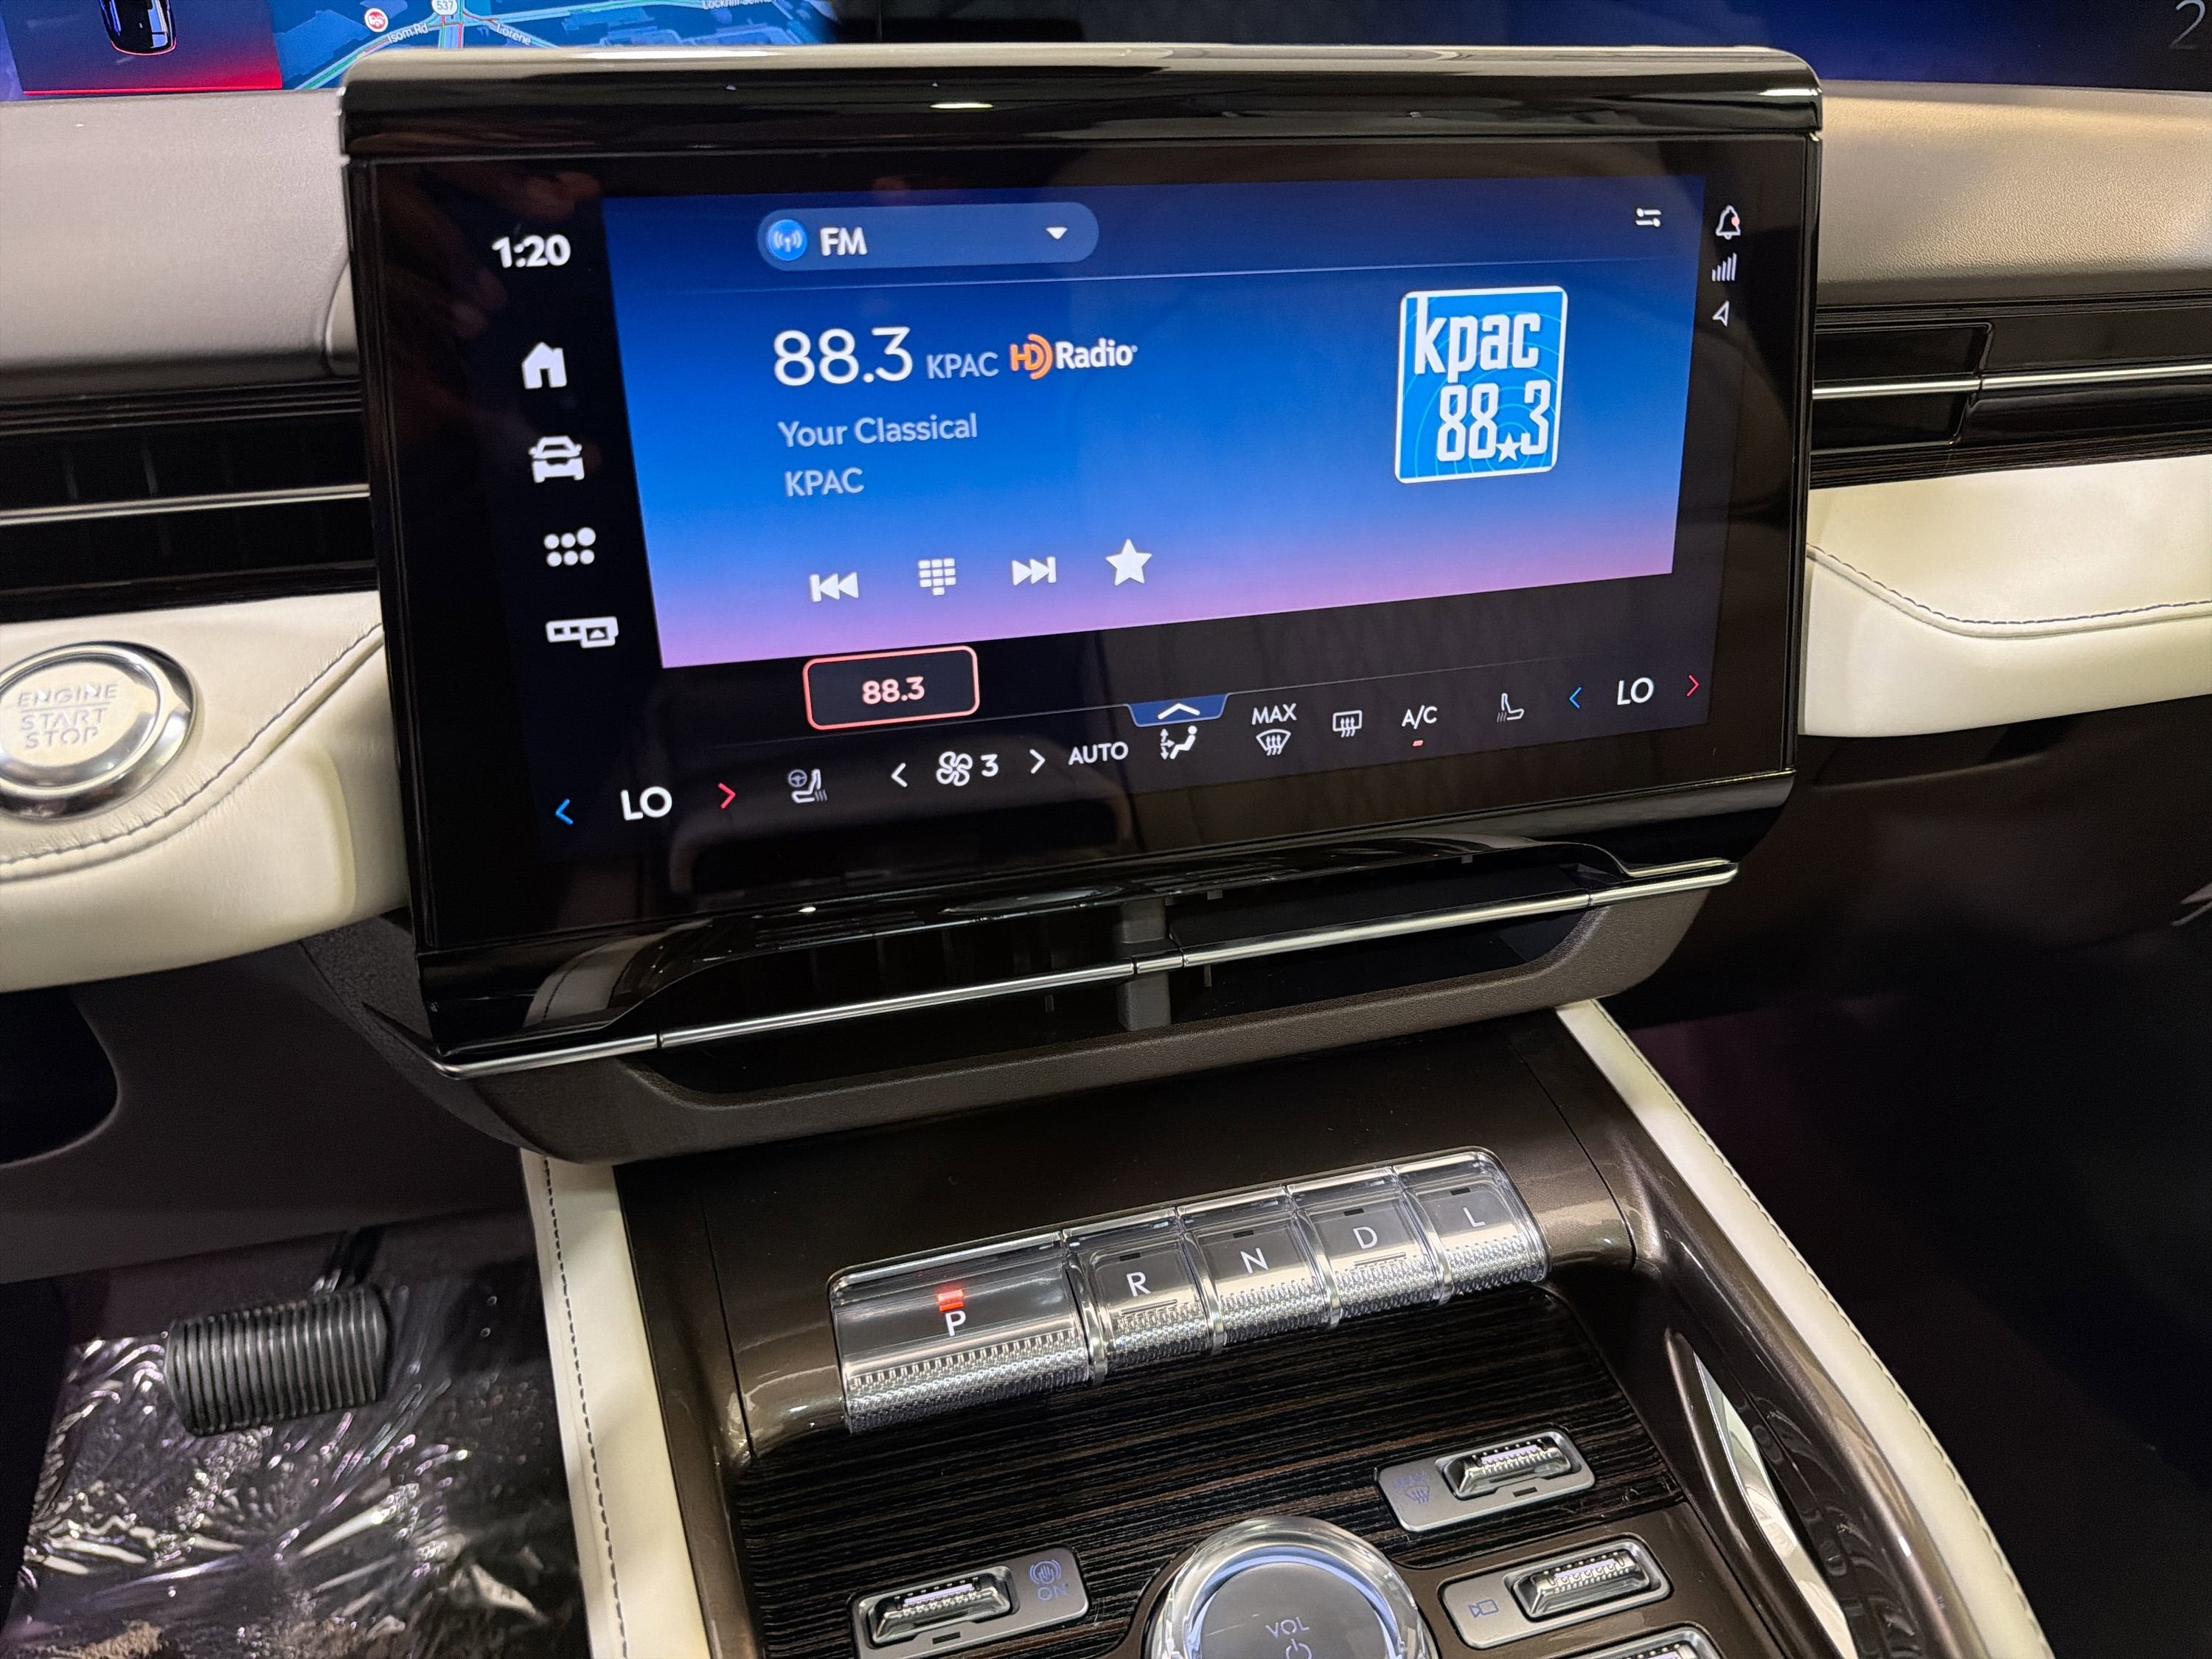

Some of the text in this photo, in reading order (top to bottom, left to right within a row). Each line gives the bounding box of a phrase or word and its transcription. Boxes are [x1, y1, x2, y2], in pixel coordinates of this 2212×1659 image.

[437, 0, 453, 10] 537
[388, 23, 429, 44] Isom Rd
[496, 22, 532, 46] Lorene
[2169, 0, 2205, 49] 2
[492, 234, 571, 268] 1:20
[819, 227, 868, 257] FM
[1413, 293, 1541, 383] kpac
[773, 326, 914, 386] 88.3
[926, 351, 999, 379] KPAC
[778, 412, 978, 448] Your Classical
[785, 466, 864, 498] KPAC
[17, 682, 119, 708] ENGINE
[862, 675, 926, 706] 88.3
[1616, 677, 1655, 706] LO
[20, 707, 109, 731] START
[1251, 702, 1298, 726] MAX
[1400, 704, 1439, 730] A/C
[24, 726, 100, 750] STOP
[980, 753, 1000, 777] 3
[1067, 741, 1130, 766] AUTO
[619, 785, 672, 821] LO
[1462, 1206, 1485, 1228] L
[1354, 1225, 1379, 1251] D
[1239, 1246, 1267, 1273] N
[1127, 1270, 1152, 1296] R
[944, 1310, 967, 1337] P
[1265, 1615, 1310, 1638] VOL
